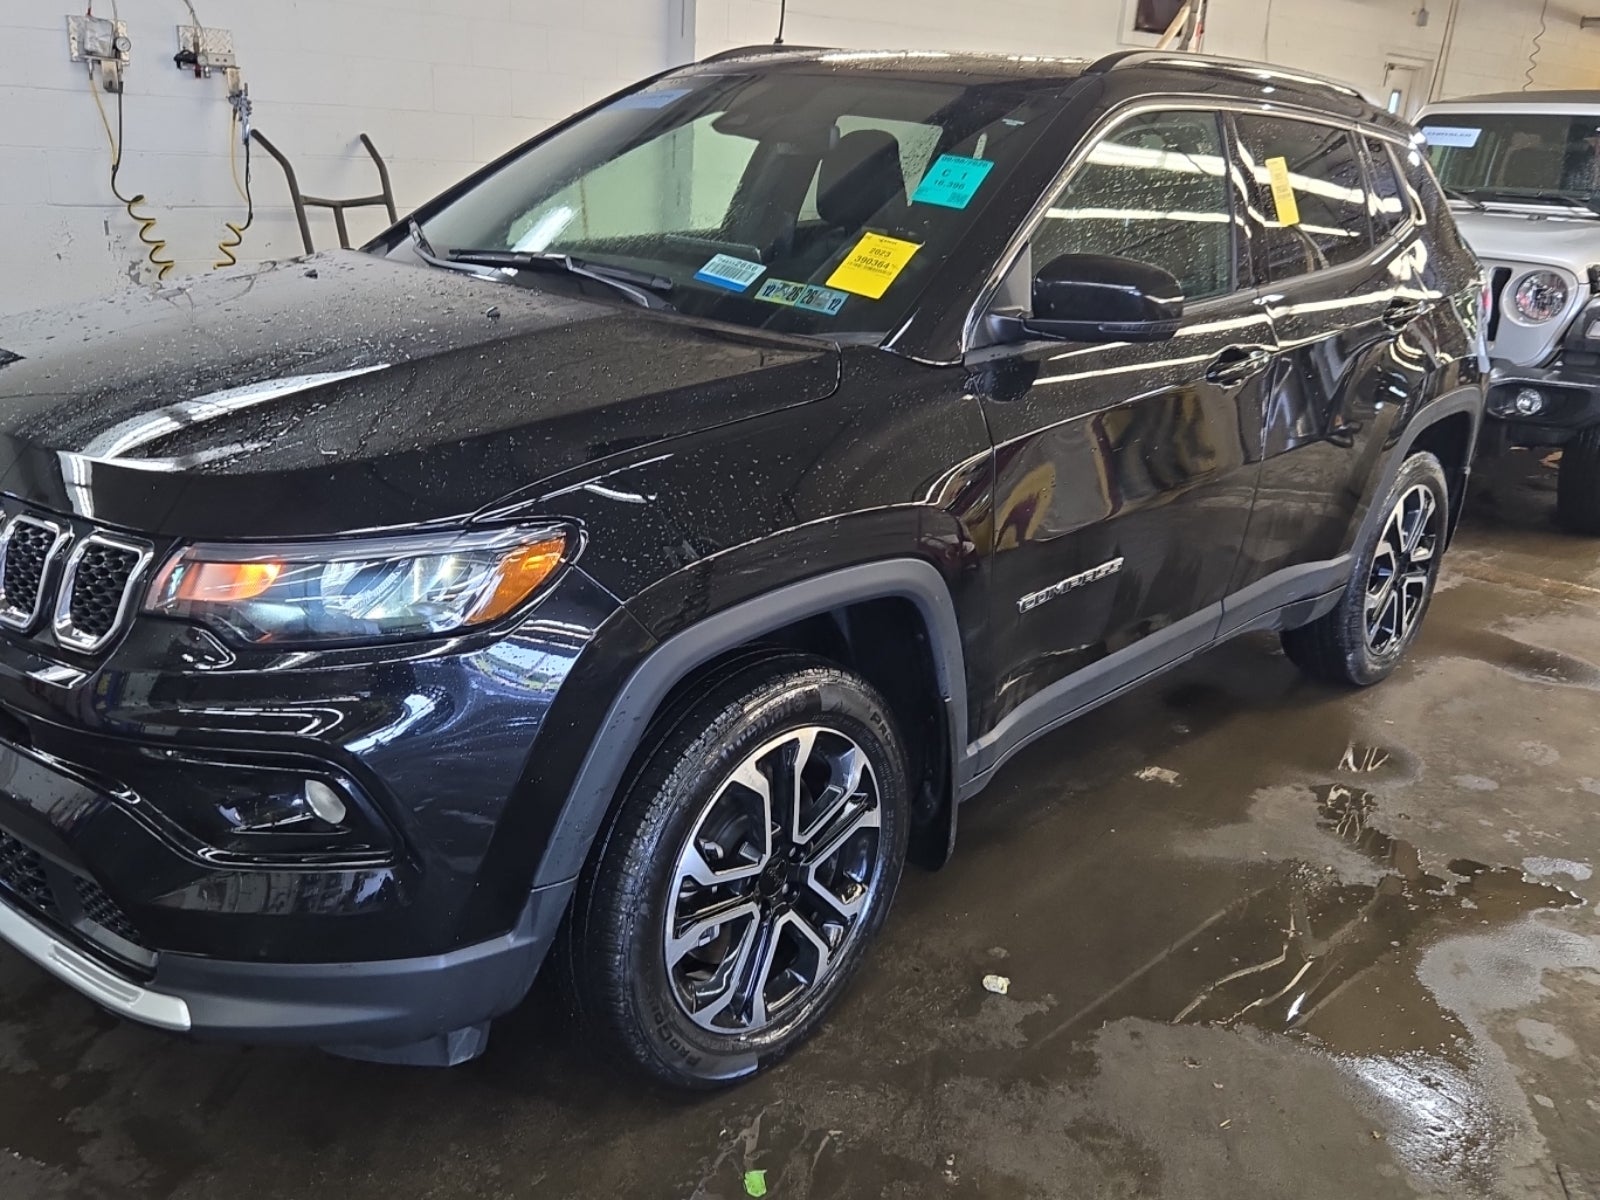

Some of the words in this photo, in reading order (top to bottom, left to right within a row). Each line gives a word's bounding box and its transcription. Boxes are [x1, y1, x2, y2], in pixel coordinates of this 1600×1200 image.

[941, 168, 952, 178] C
[854, 255, 891, 269] 390364
[762, 284, 776, 297] 12
[827, 298, 842, 311] 12
